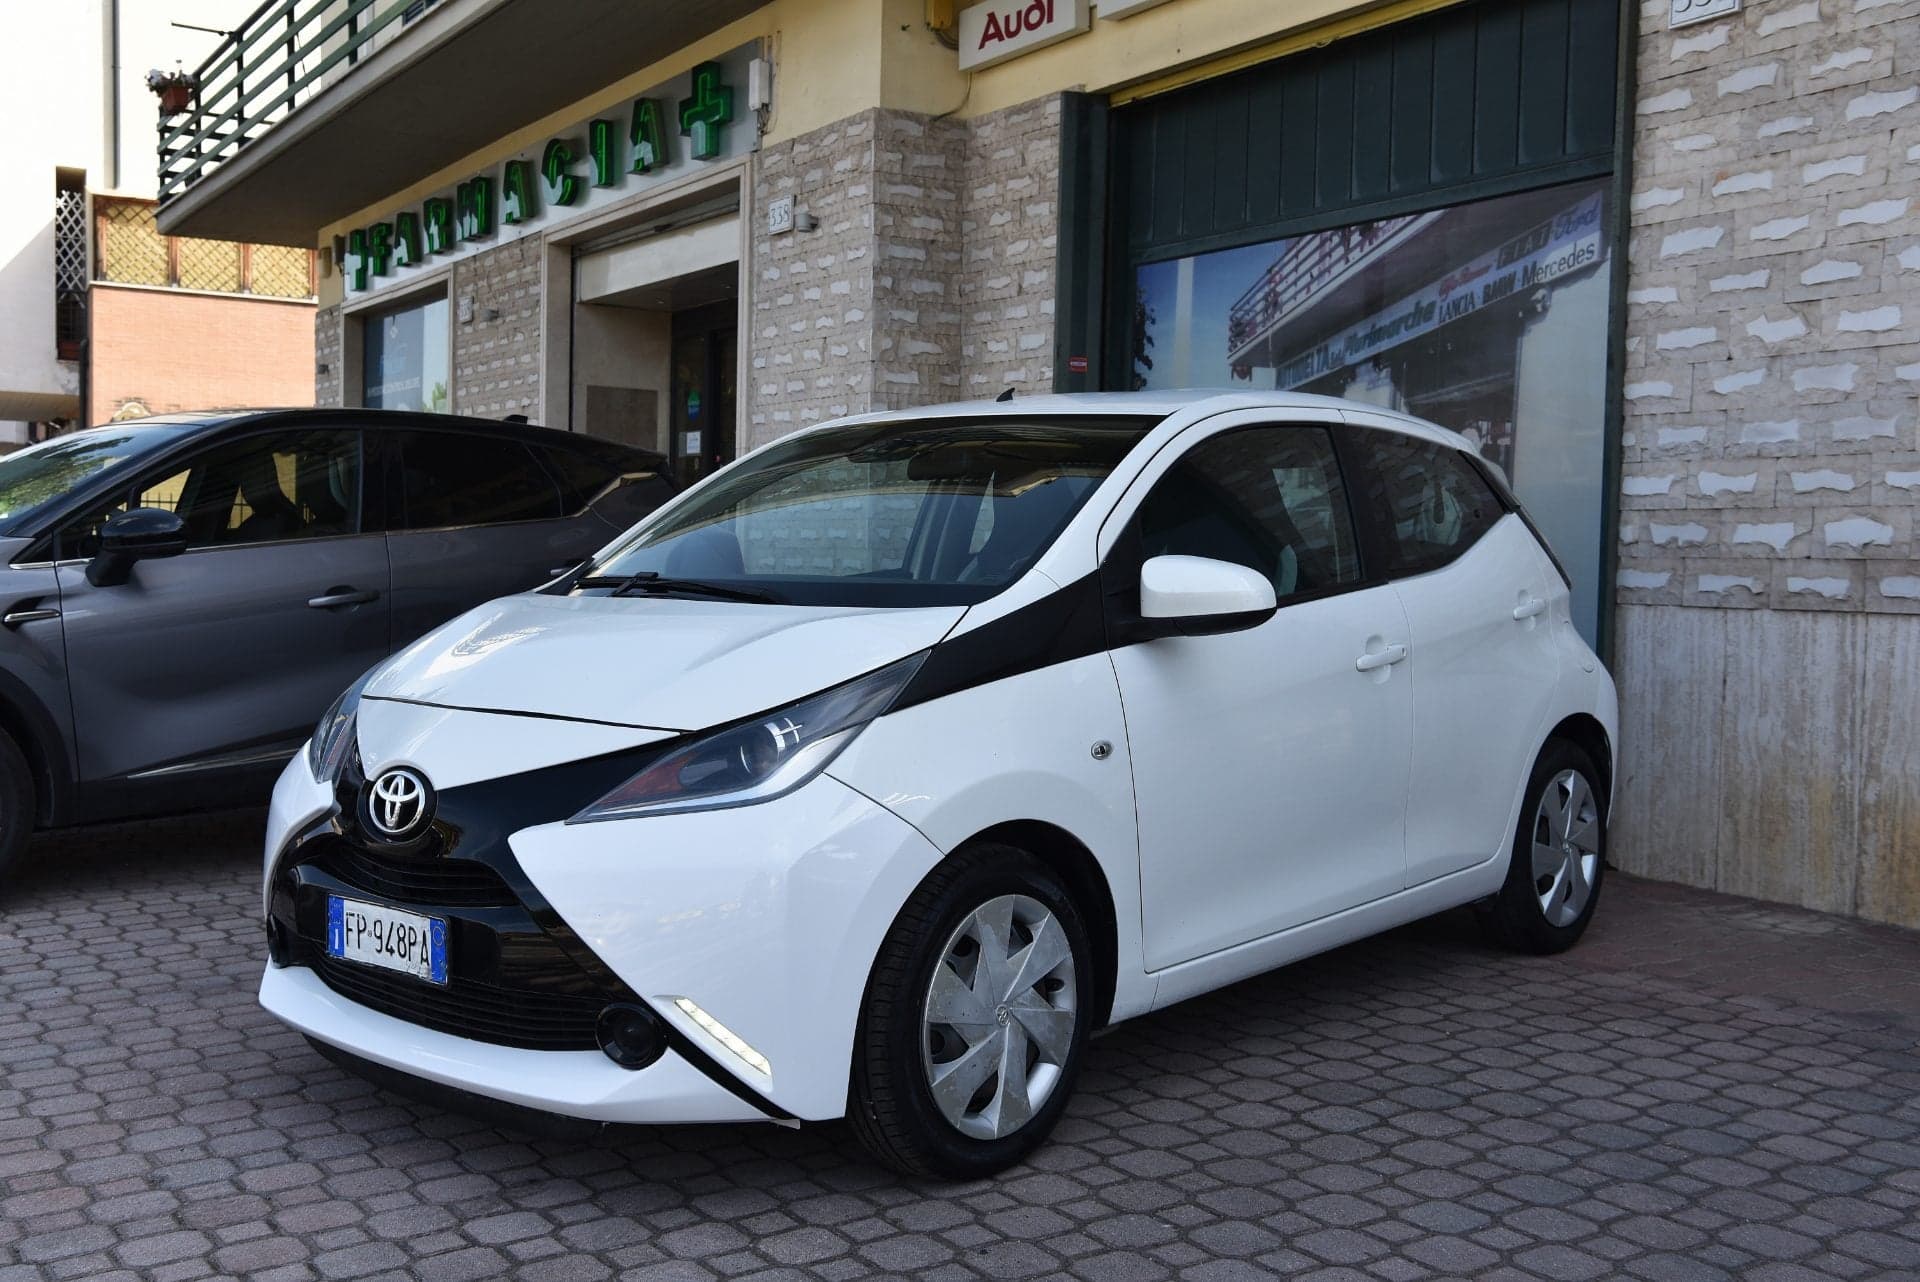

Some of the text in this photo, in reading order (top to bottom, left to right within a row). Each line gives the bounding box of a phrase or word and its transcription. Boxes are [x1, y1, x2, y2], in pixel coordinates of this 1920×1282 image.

[978, 0, 1054, 50] Audi
[369, 97, 669, 277] FARMACIA
[1521, 242, 1595, 287] Mercedes
